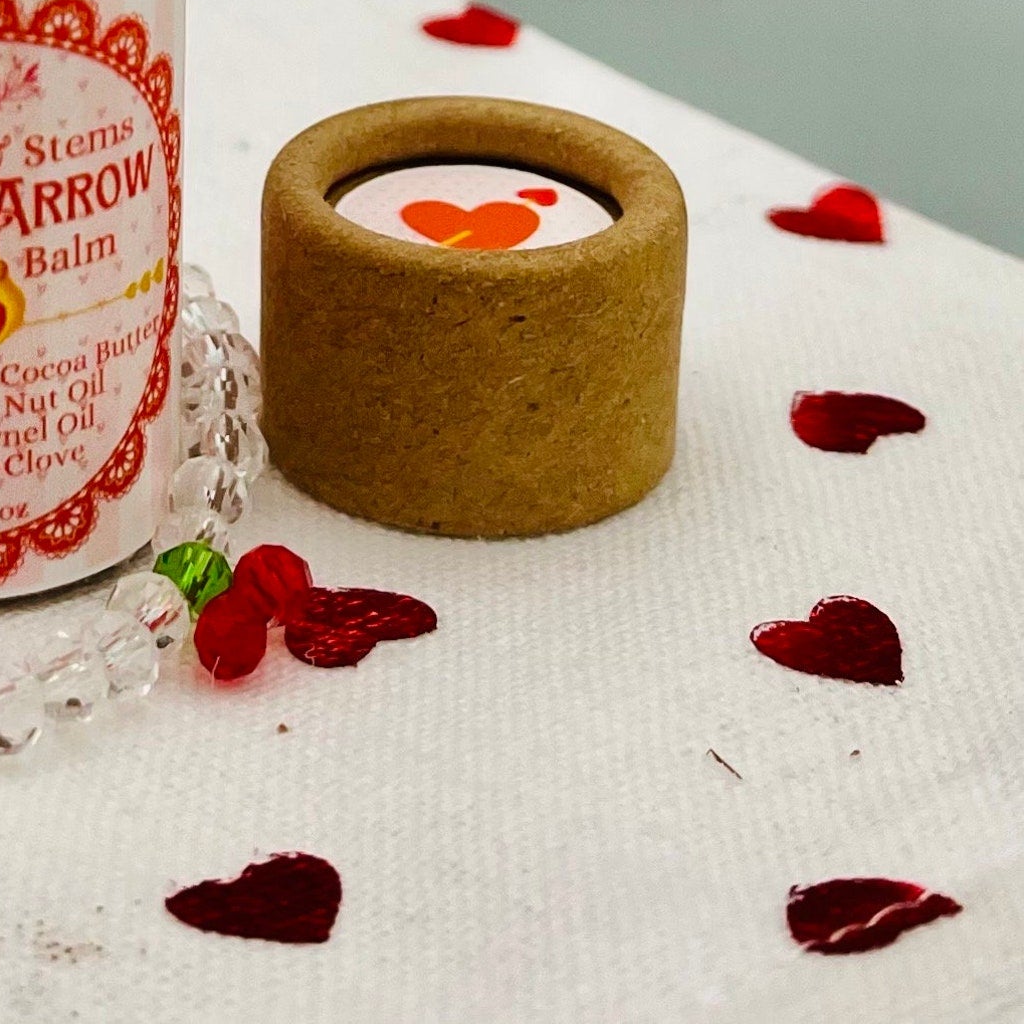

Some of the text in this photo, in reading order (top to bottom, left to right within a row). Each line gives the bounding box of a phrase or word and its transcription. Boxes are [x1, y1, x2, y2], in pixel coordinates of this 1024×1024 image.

[23, 116, 134, 168] Stems
[23, 231, 116, 278] Balm
[95, 314, 163, 360] Butter
[4, 387, 59, 418] Nut
[67, 368, 107, 404] Oil
[56, 404, 97, 435] Oil
